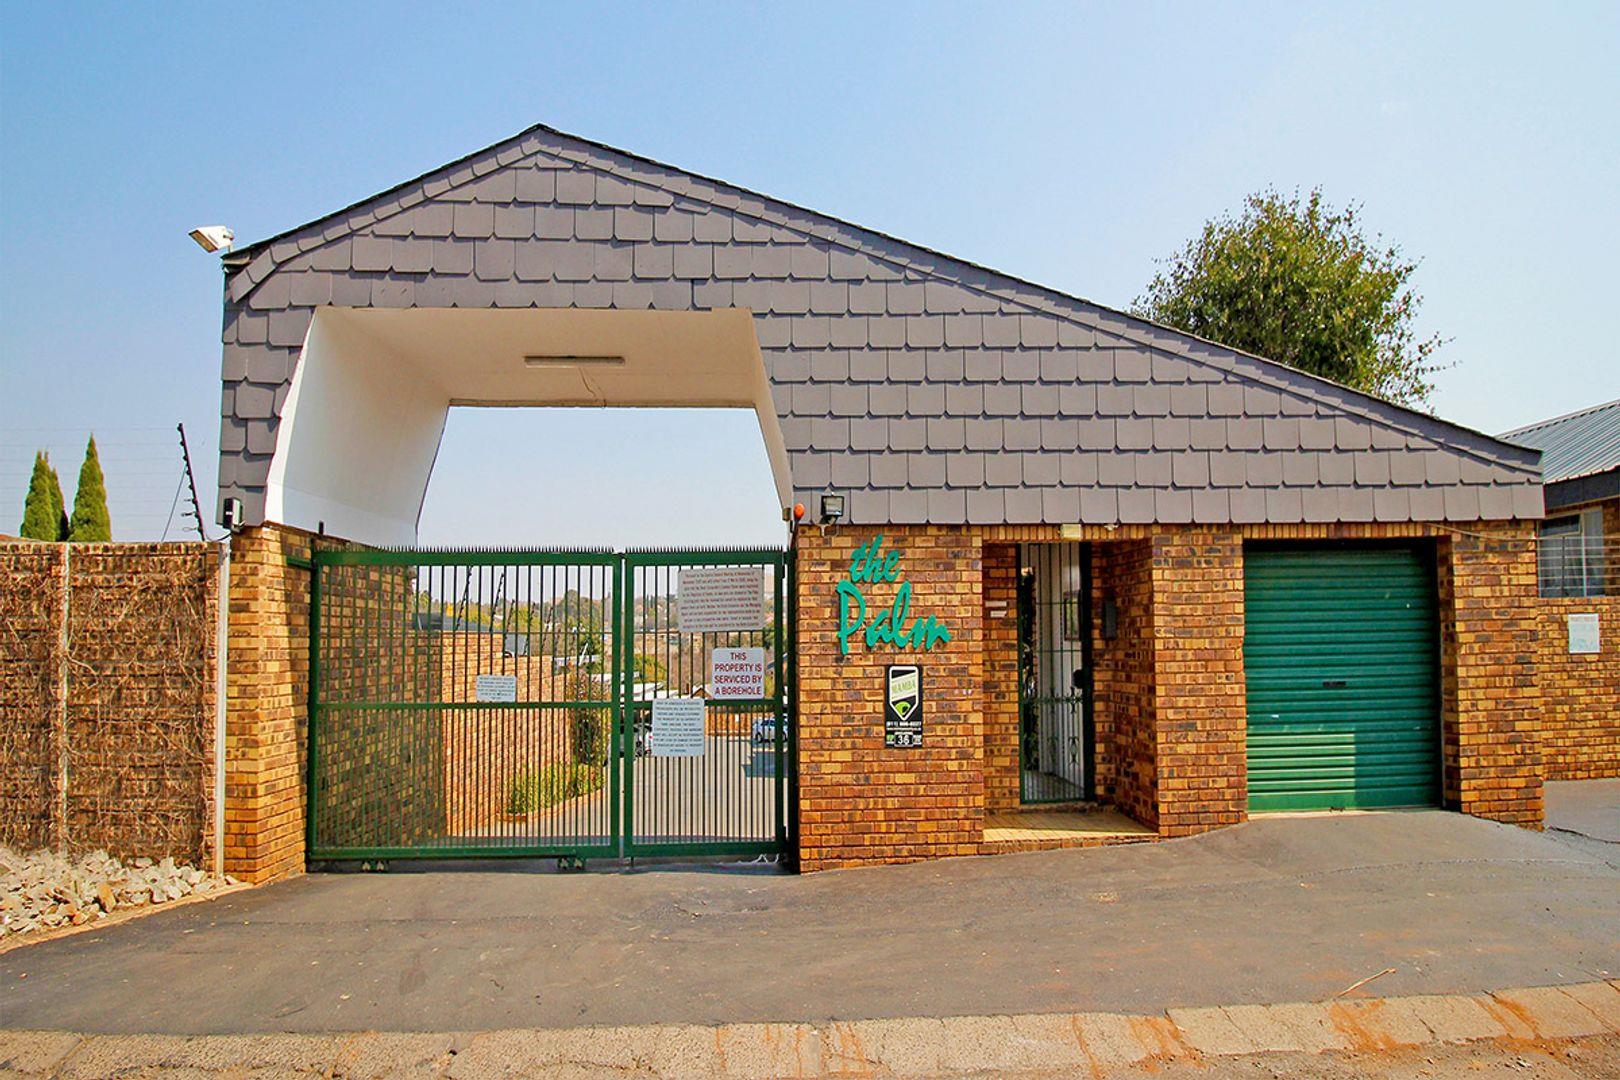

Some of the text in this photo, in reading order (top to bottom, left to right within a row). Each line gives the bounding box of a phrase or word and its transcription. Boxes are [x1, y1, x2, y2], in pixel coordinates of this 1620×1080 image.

[848, 534, 901, 582] the
[836, 579, 952, 655] Palm
[730, 652, 747, 661] THIS
[714, 663, 762, 672] PROPERTY IS
[714, 675, 763, 684] SERVICED BY
[715, 686, 761, 695] A BOREHOLE
[897, 734, 910, 745] 36
